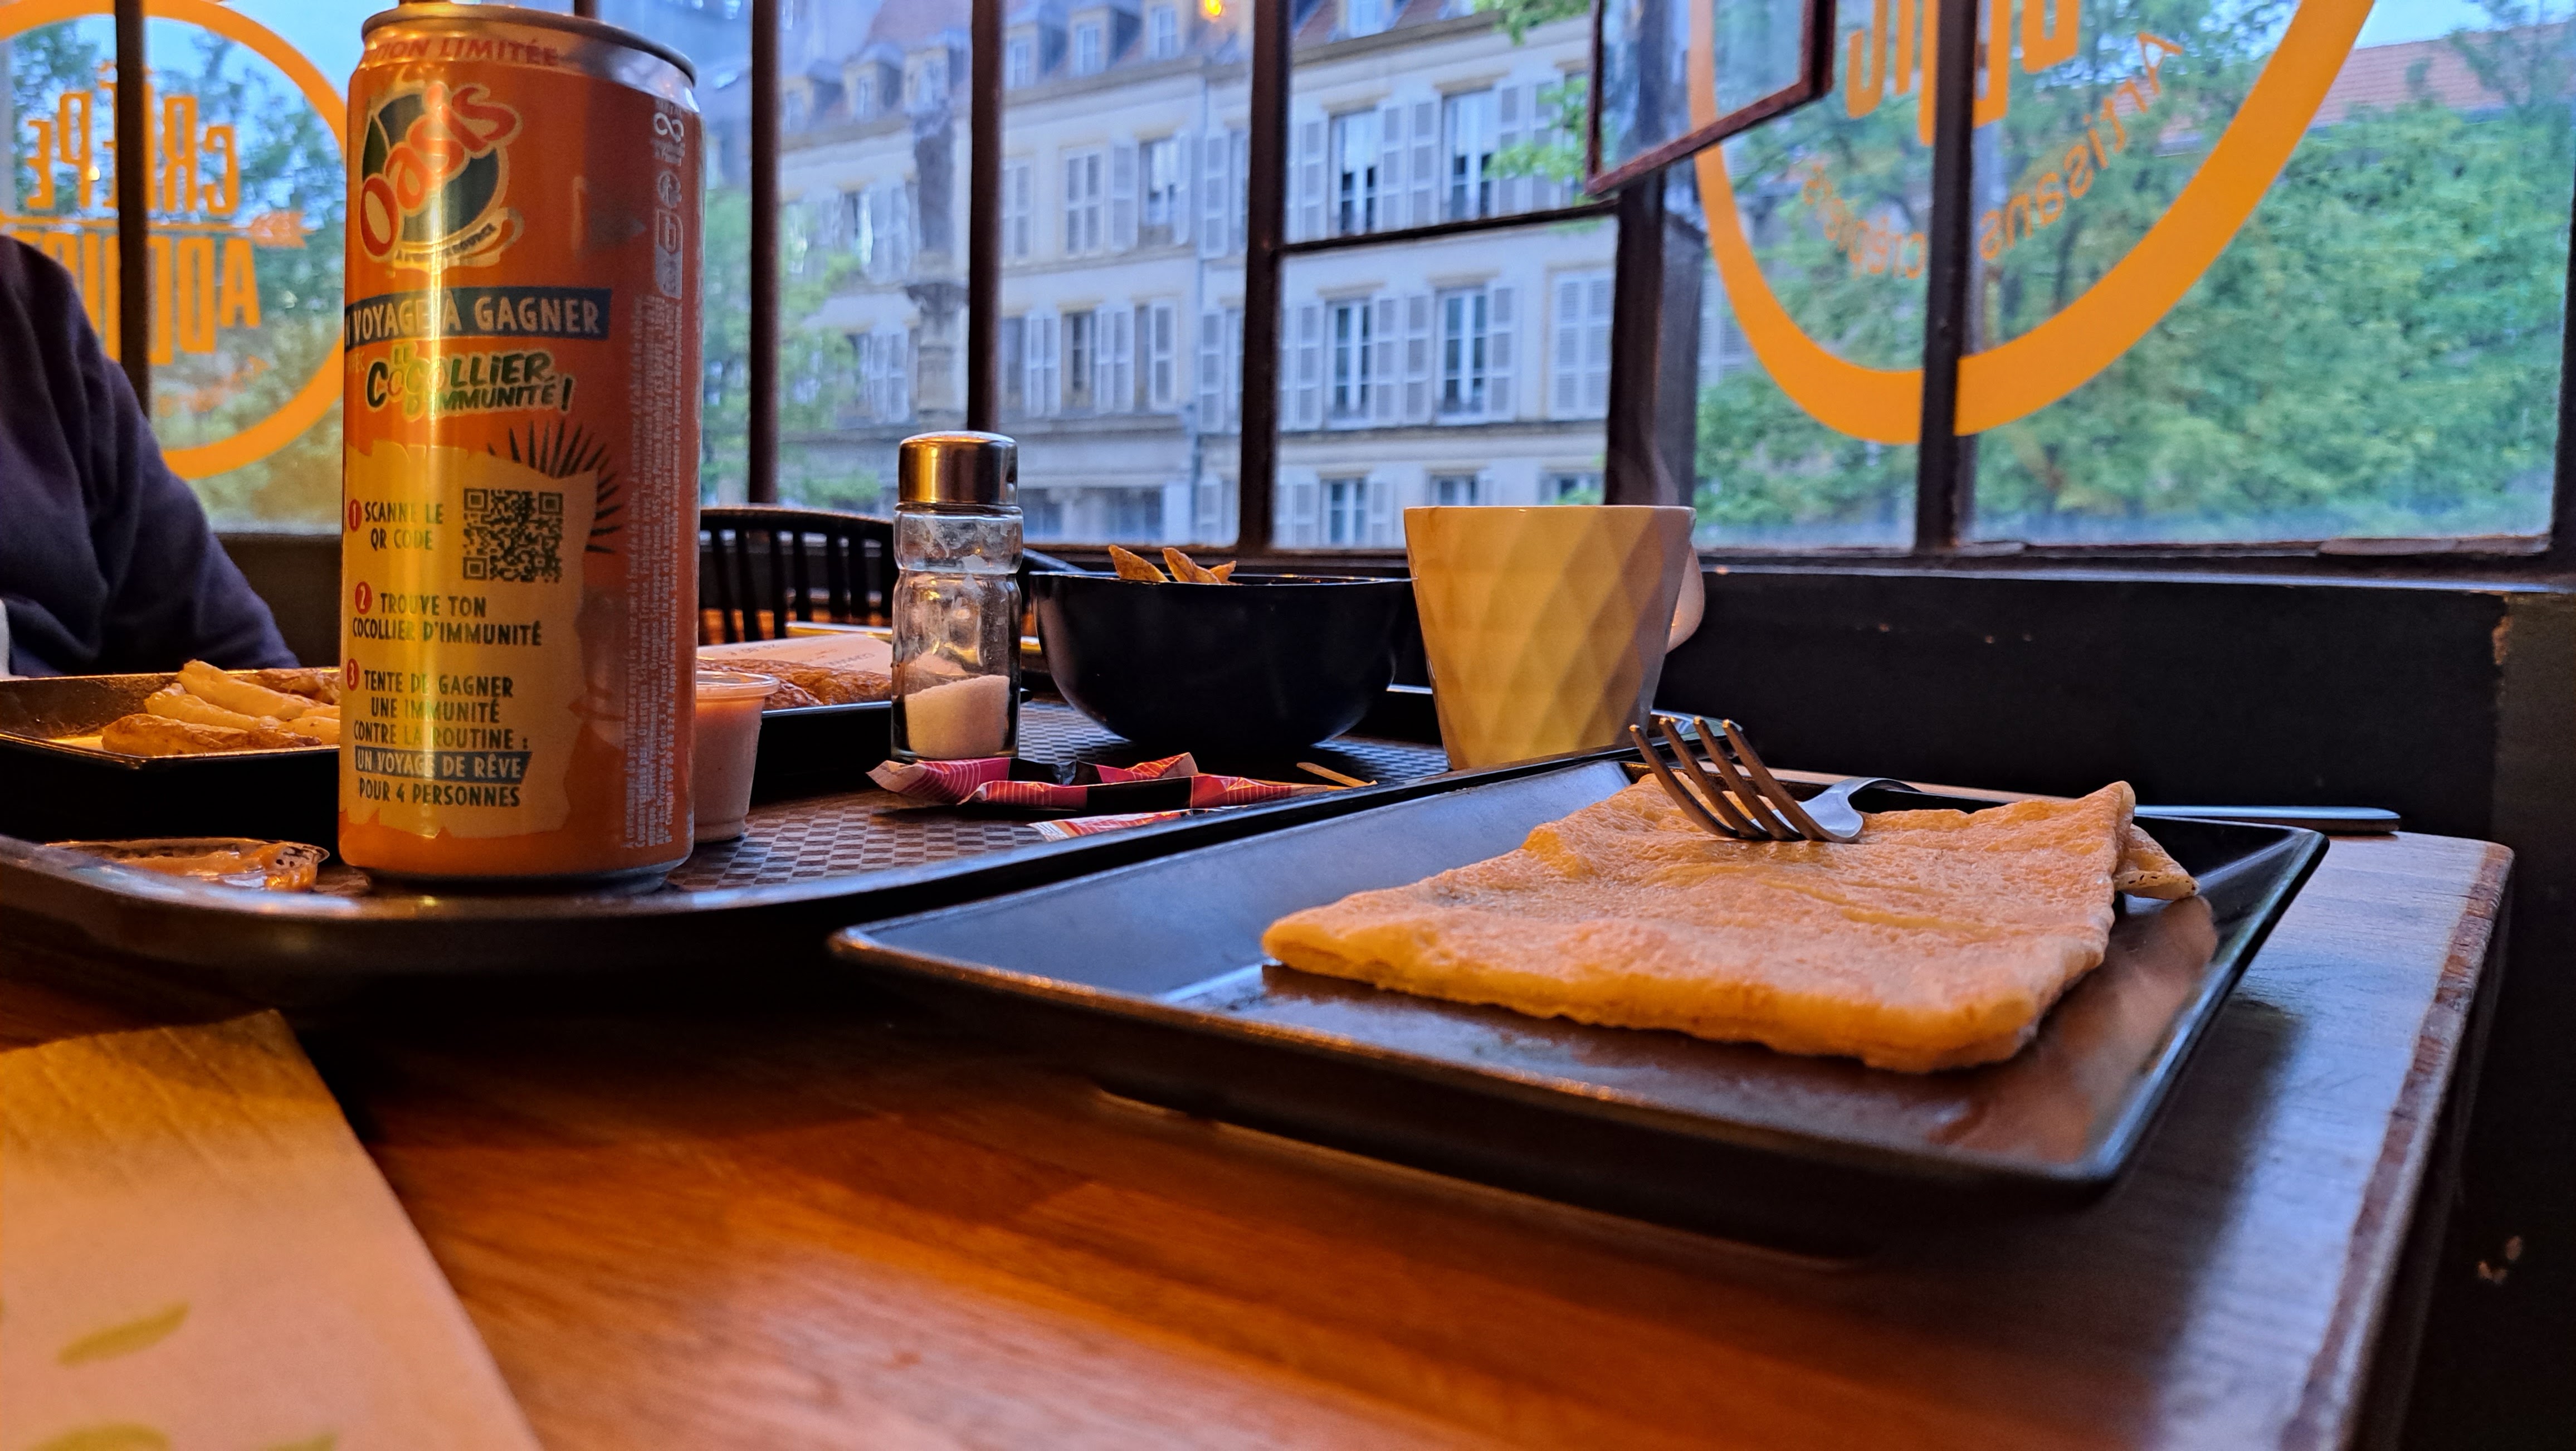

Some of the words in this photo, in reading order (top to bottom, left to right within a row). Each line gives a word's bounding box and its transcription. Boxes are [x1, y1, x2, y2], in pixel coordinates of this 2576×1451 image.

[438, 38, 557, 66] LIMITÉE
[360, 83, 517, 257] Oasis
[354, 298, 432, 342] VOYAGE
[442, 289, 462, 332] À
[475, 295, 601, 334] GAGNER
[426, 503, 443, 524] LE
[371, 528, 387, 551] QR
[394, 529, 432, 551] CODE
[380, 592, 440, 616] TROUVE
[448, 596, 487, 618] TON
[353, 617, 416, 640] COCOLLIER
[423, 621, 542, 646] D'IMMUNITÉ
[364, 670, 403, 693] TENTE
[411, 673, 430, 695] DE
[438, 675, 514, 698] GAGNER
[371, 697, 398, 718] UNE
[405, 698, 500, 723] IMMUNITÉ
[354, 719, 397, 744] CONTRE
[404, 726, 422, 746] LA
[433, 727, 514, 749] ROUTINE
[357, 749, 373, 771] UN
[378, 752, 435, 777] VOYAGE
[442, 756, 465, 777] DE
[474, 753, 521, 779] RÊVE
[359, 777, 390, 802] POUR
[397, 783, 405, 803] 4
[413, 784, 520, 807] PERSONNES
